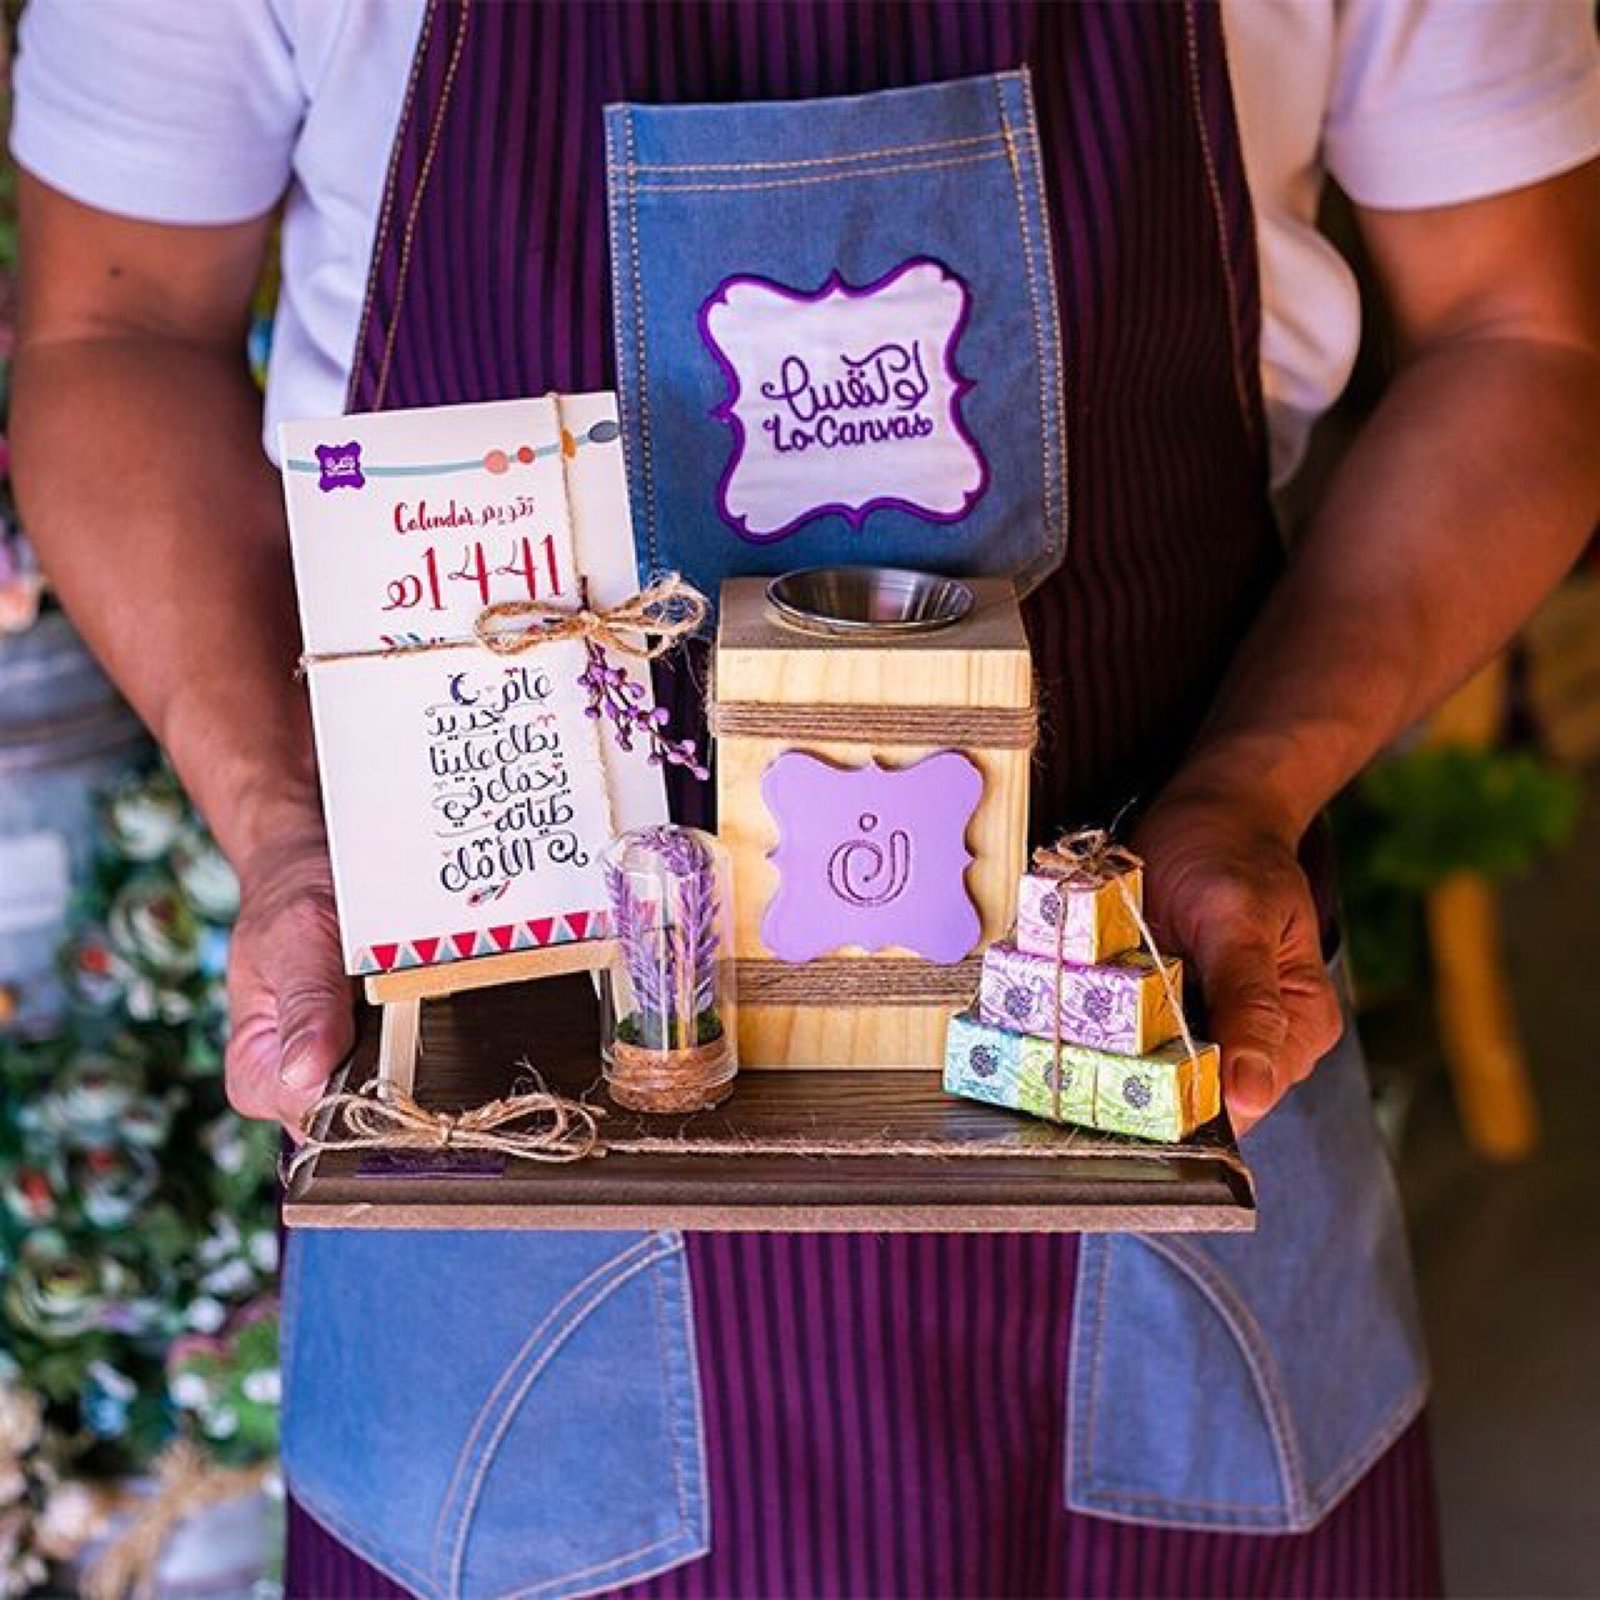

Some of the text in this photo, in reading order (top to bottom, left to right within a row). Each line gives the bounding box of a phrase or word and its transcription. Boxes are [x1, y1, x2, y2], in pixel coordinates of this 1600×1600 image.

[815, 412, 934, 449] Canvas
[394, 498, 475, 535] Calendar
[482, 494, 535, 527] تقويم
